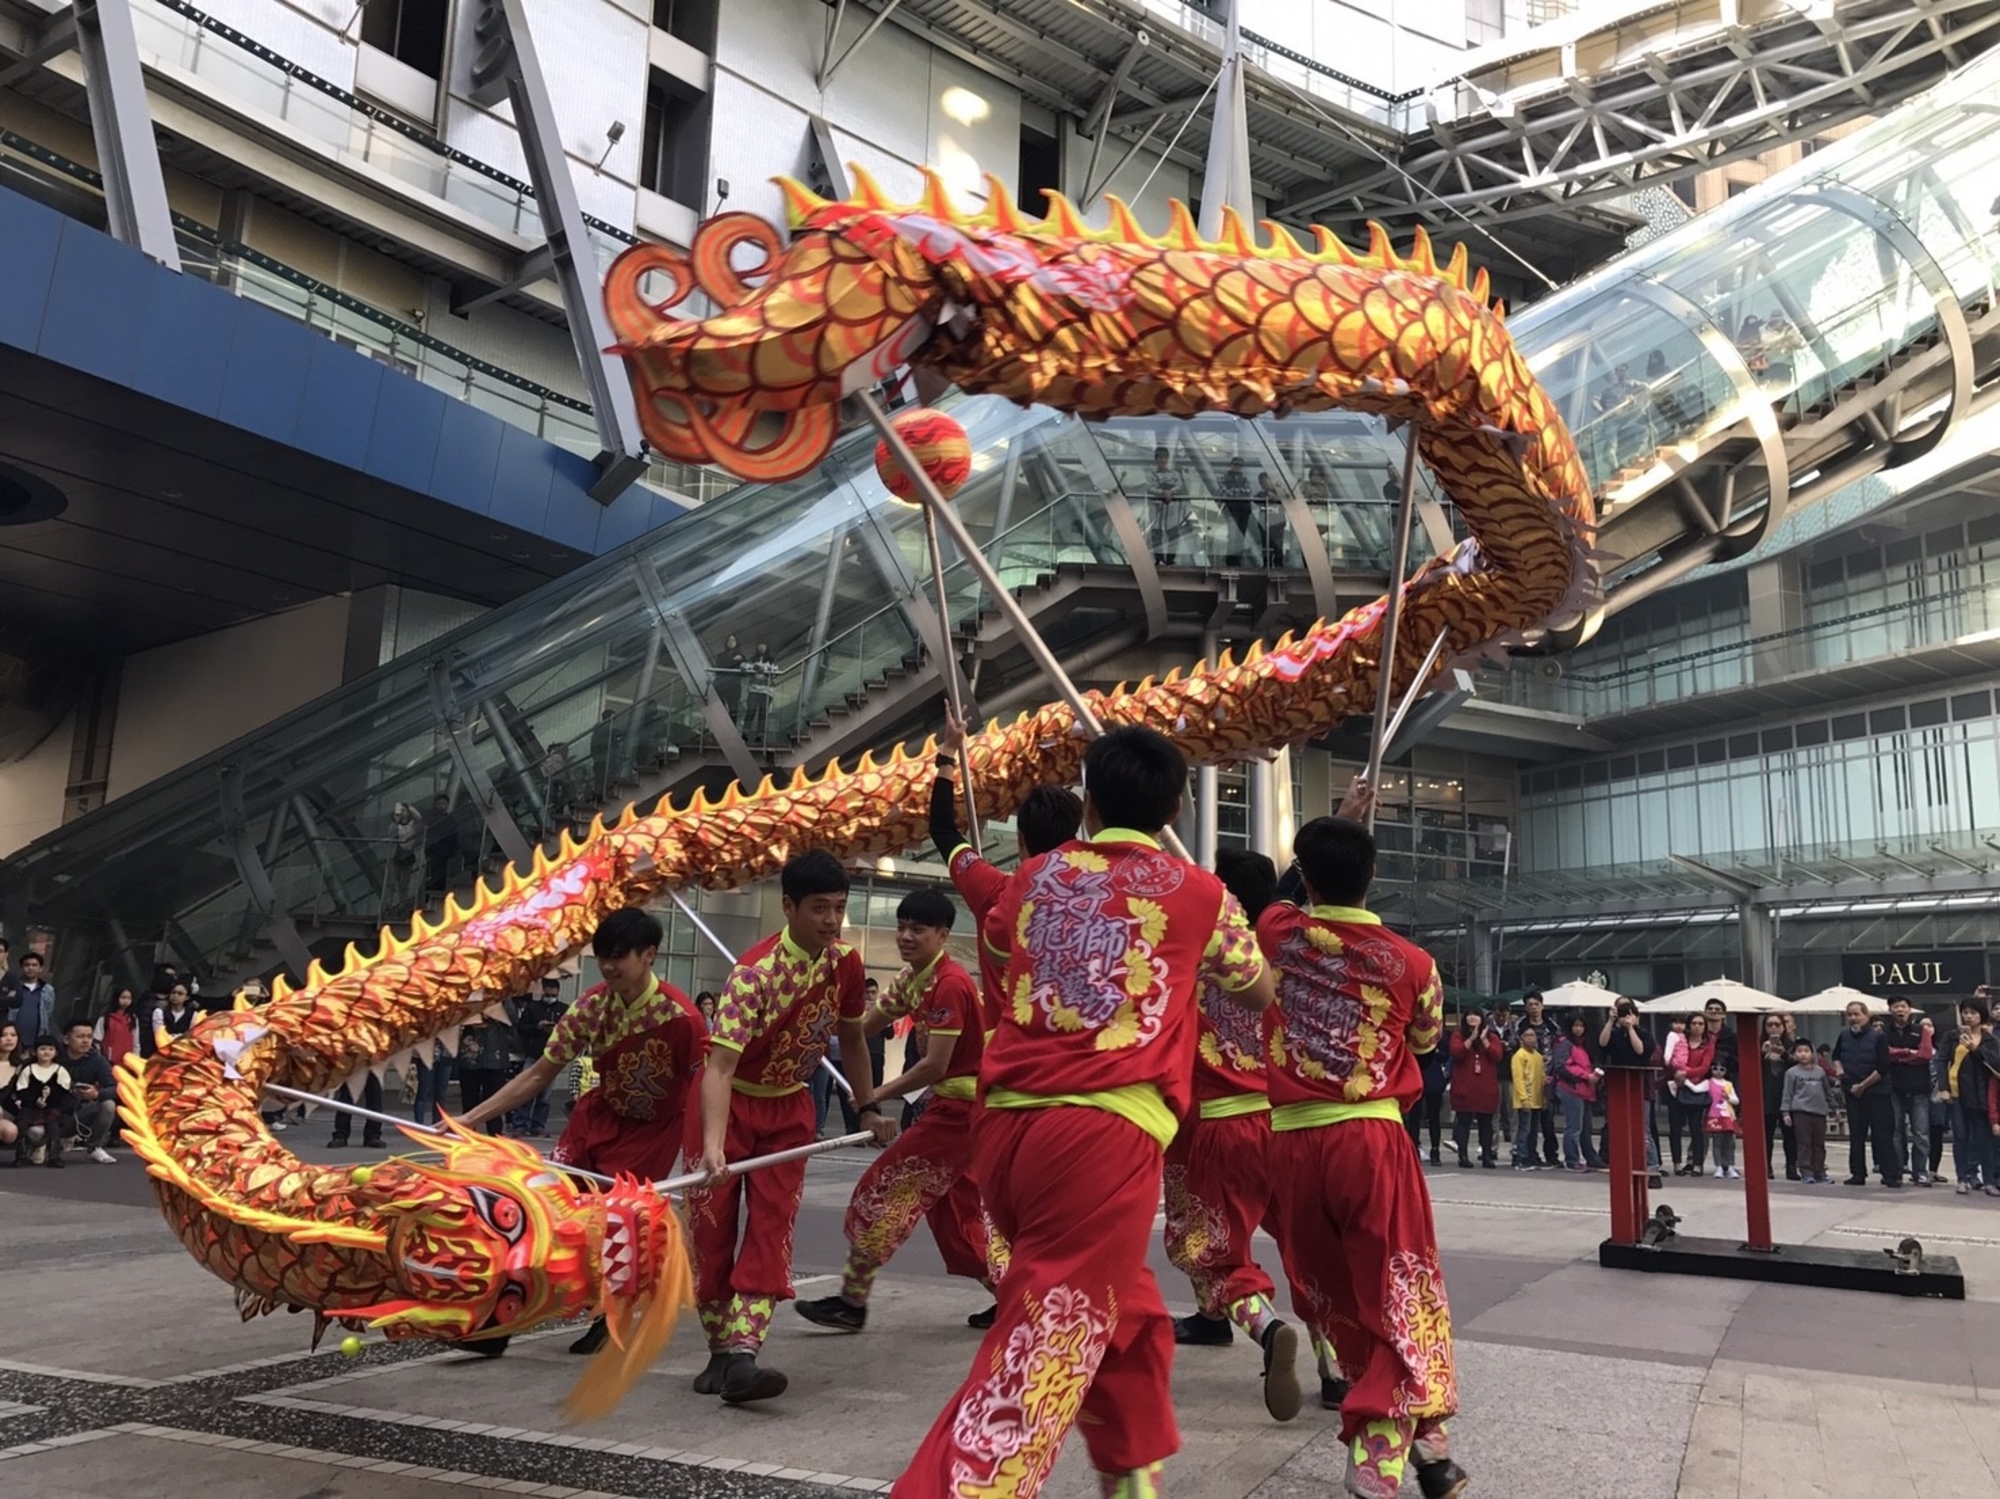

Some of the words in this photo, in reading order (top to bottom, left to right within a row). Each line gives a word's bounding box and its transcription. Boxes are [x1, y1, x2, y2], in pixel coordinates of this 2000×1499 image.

[1023, 851, 1111, 920] 太子
[1026, 901, 1128, 975] 龍獅
[1869, 962, 1952, 985] PAUL
